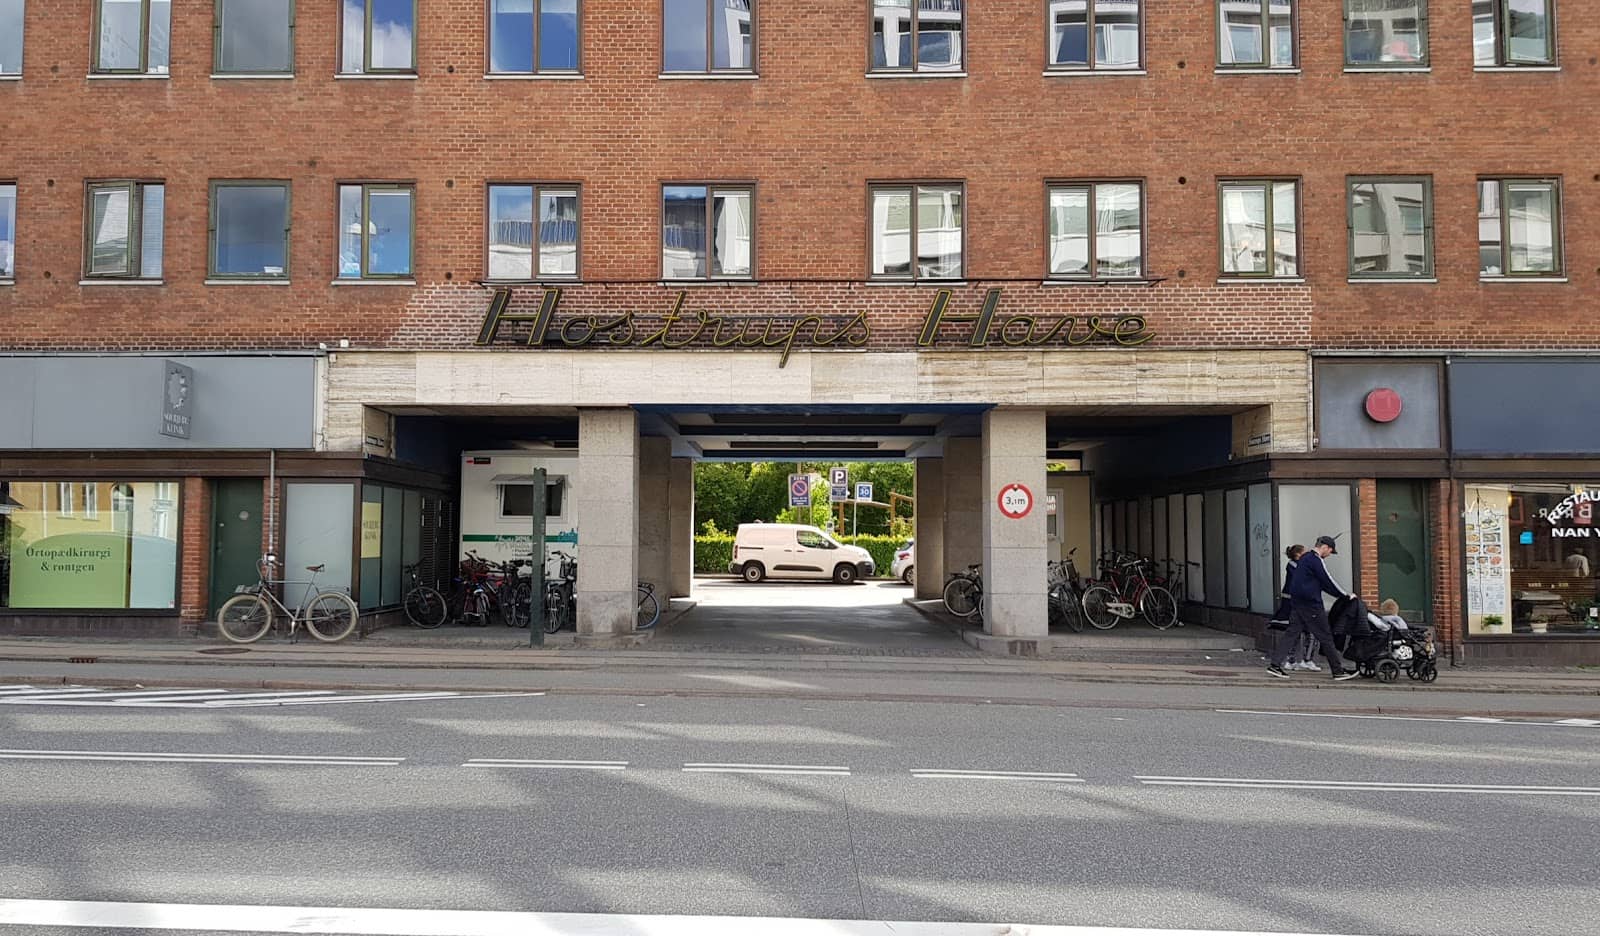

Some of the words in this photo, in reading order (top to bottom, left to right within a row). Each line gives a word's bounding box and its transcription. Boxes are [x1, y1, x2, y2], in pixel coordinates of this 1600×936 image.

[473, 287, 871, 369] Hostrups
[917, 287, 1156, 347] Have
[835, 471, 845, 483] P
[859, 488, 870, 496] 30
[1547, 490, 1600, 525] RESTAU
[1551, 527, 1590, 538] NAN
[40, 561, 50, 572] &
